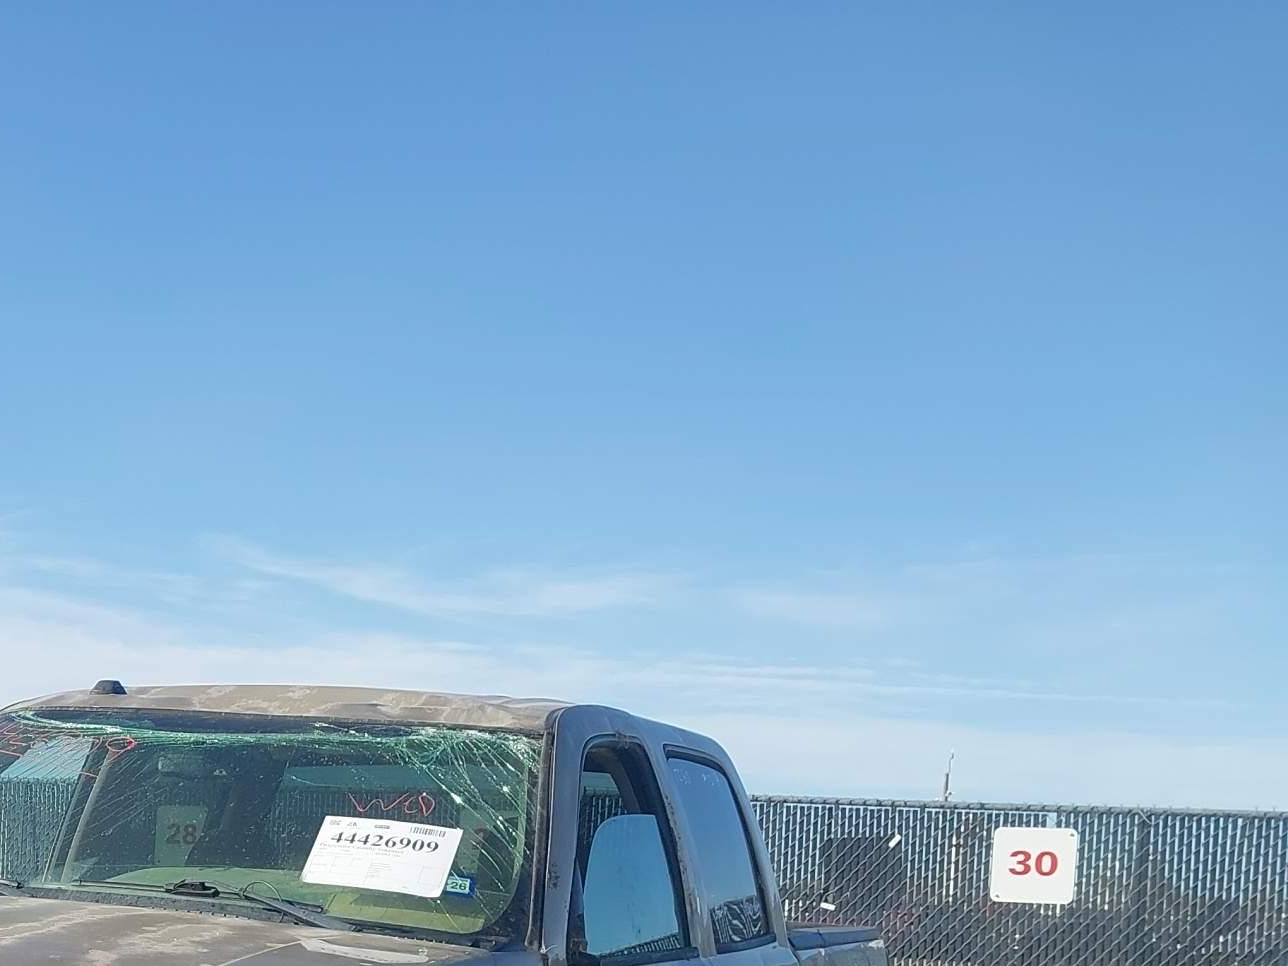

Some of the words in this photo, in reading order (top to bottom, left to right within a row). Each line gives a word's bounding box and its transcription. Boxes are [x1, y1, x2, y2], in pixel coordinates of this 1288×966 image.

[166, 823, 197, 845] 28
[330, 831, 440, 853] 44426909
[1008, 851, 1058, 876] 30
